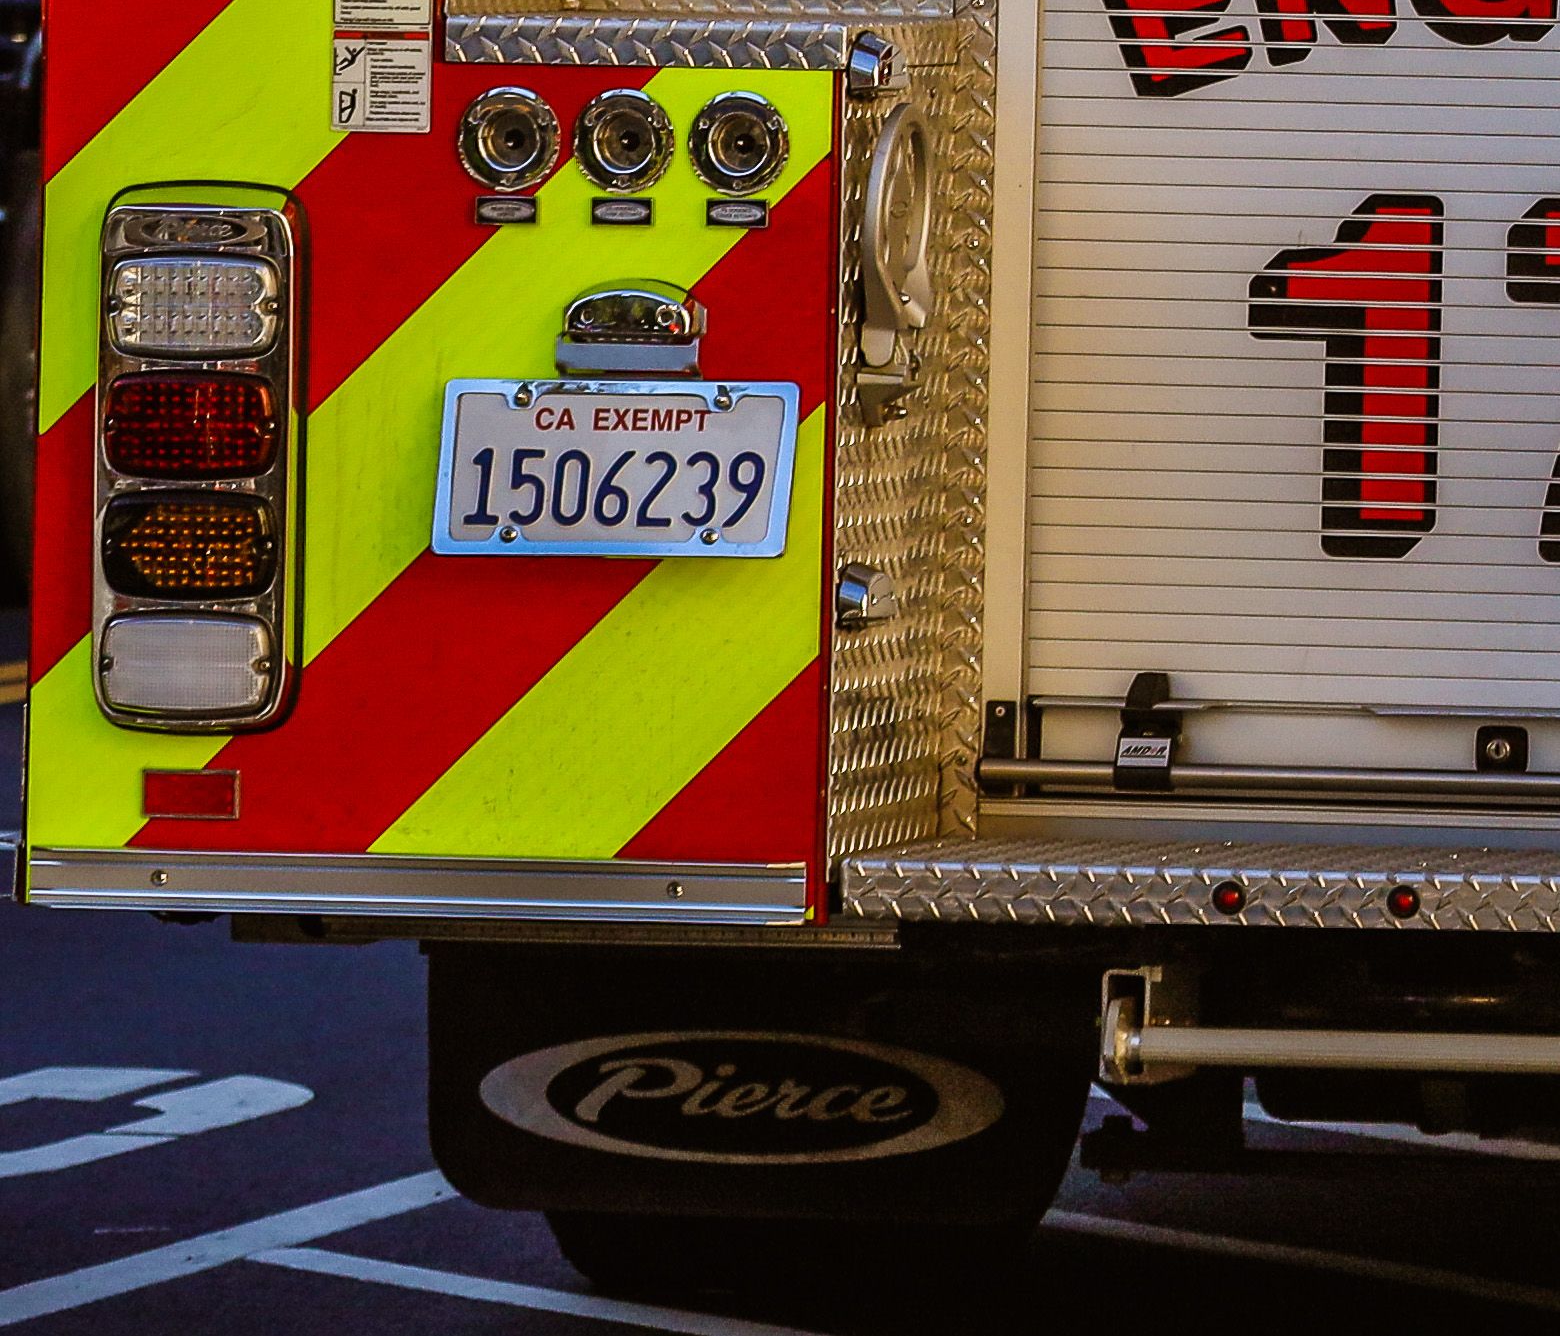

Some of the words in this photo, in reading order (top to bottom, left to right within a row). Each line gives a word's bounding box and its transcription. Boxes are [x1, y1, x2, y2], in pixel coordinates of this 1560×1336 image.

[535, 407, 576, 433] CA
[594, 407, 710, 434] EXEMPT
[463, 448, 766, 528] 1506239
[574, 1056, 913, 1124] Pierce
